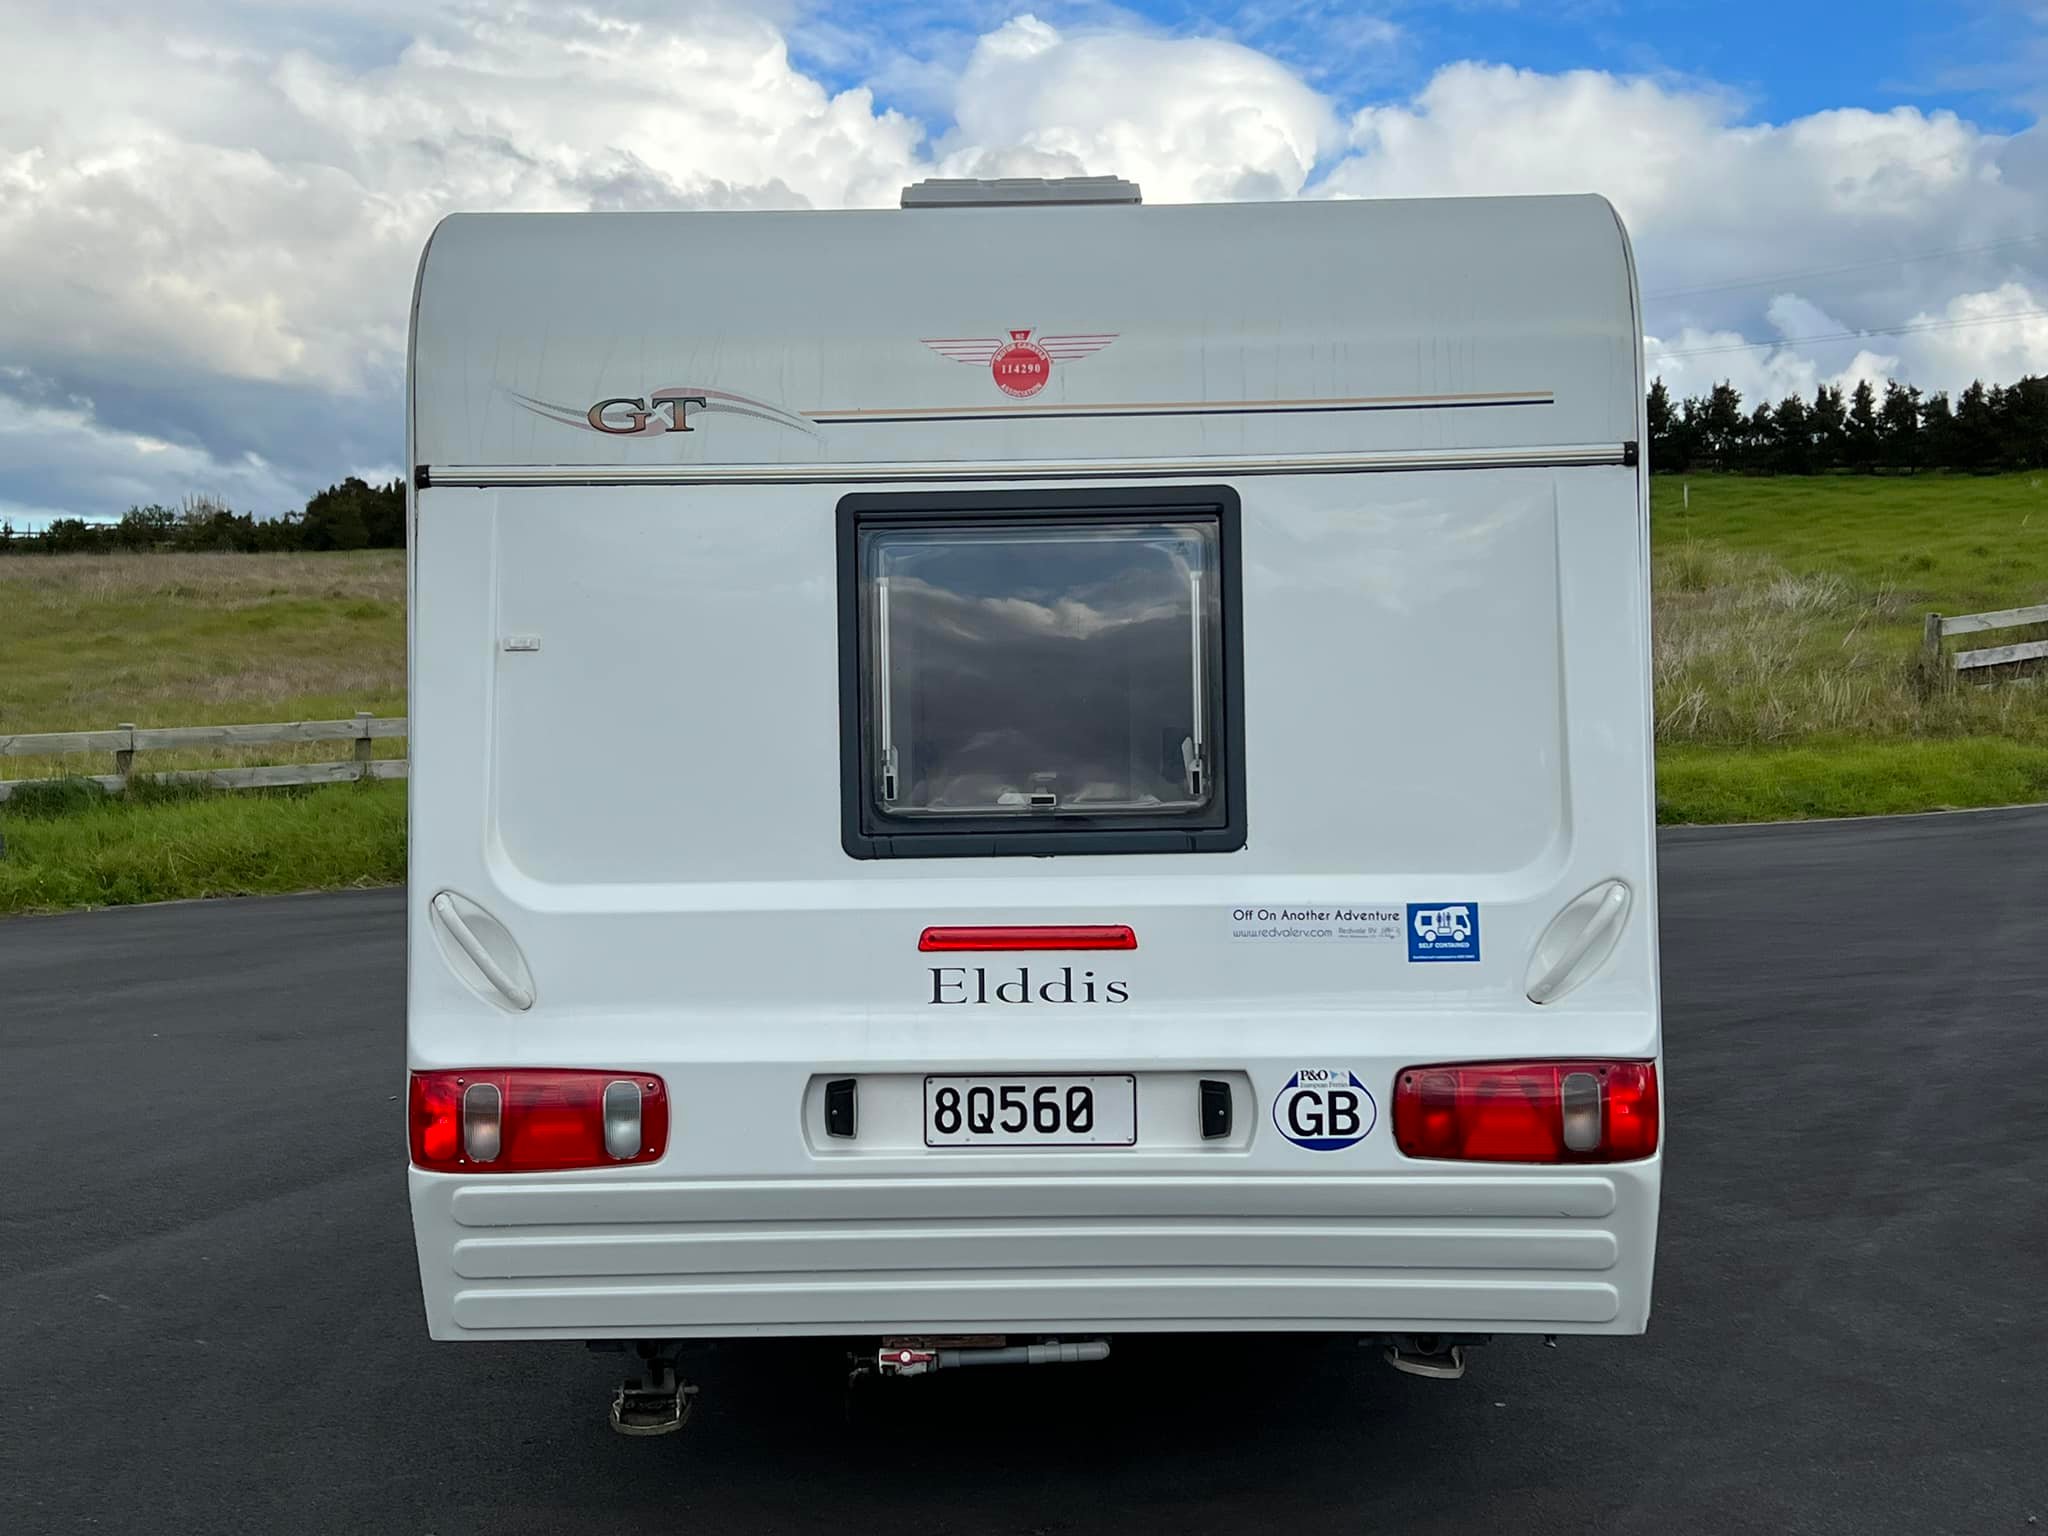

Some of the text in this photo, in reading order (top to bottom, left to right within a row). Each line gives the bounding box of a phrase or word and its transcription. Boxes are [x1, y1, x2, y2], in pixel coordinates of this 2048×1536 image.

[1001, 363, 1041, 374] 114290
[587, 396, 706, 434] GT
[1232, 908, 1400, 921] Off On Another Adventure
[1232, 926, 1333, 938] www.redvalerv.com
[927, 966, 1130, 1005] Elddis
[1300, 1069, 1328, 1081] P&O
[934, 1085, 1094, 1134] 8Q560
[1288, 1090, 1360, 1137] GB
